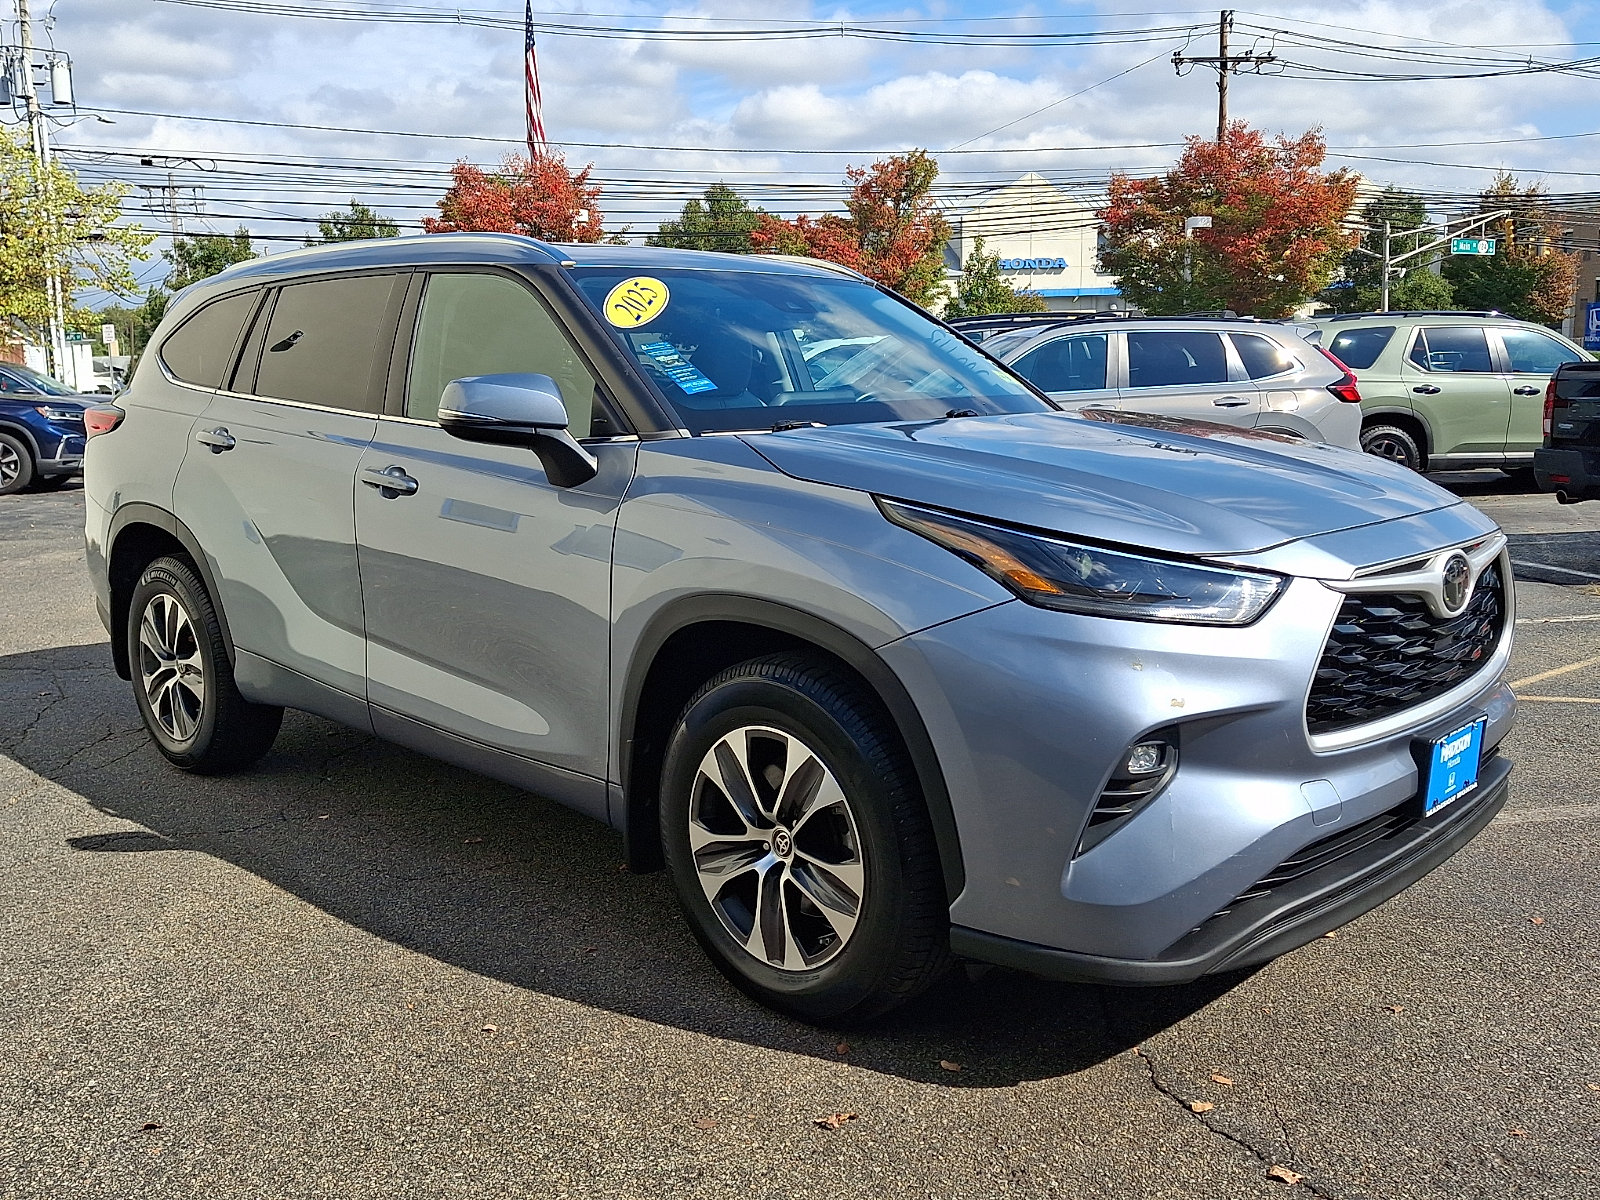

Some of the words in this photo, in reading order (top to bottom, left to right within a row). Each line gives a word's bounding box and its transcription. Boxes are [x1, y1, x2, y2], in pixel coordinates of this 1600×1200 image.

[998, 258, 1068, 270] HONDA
[614, 282, 658, 322] 2025
[150, 570, 177, 586] MICHELIN
